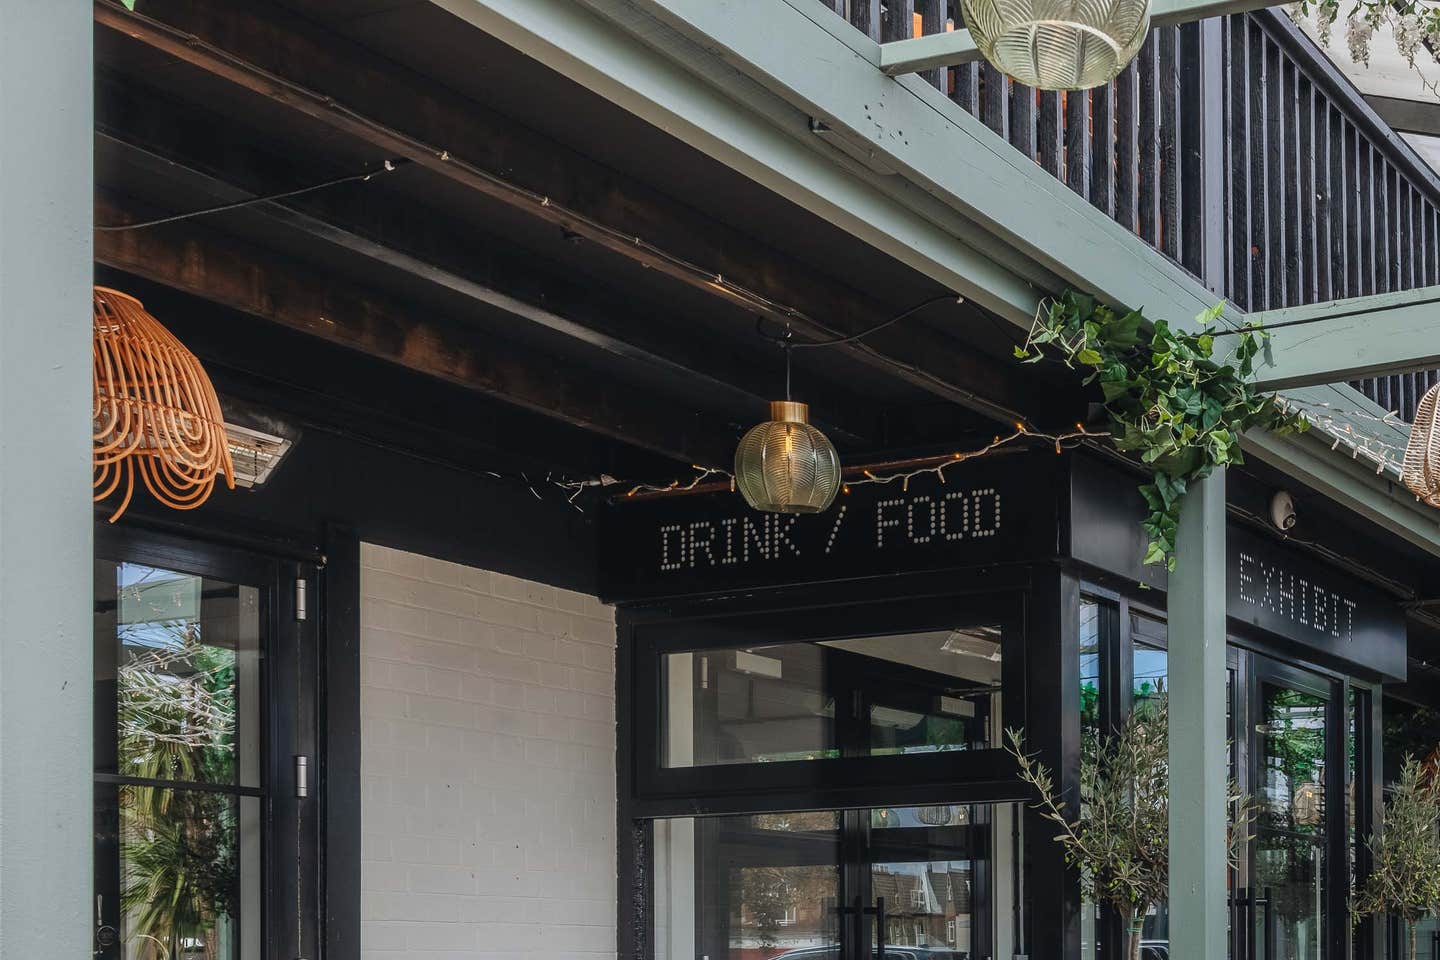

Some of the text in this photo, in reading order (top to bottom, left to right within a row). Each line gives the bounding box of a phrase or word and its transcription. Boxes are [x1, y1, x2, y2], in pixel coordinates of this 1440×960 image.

[660, 487, 1001, 571] DRINK / FOOD
[1239, 552, 1357, 642] EXHIBIT
